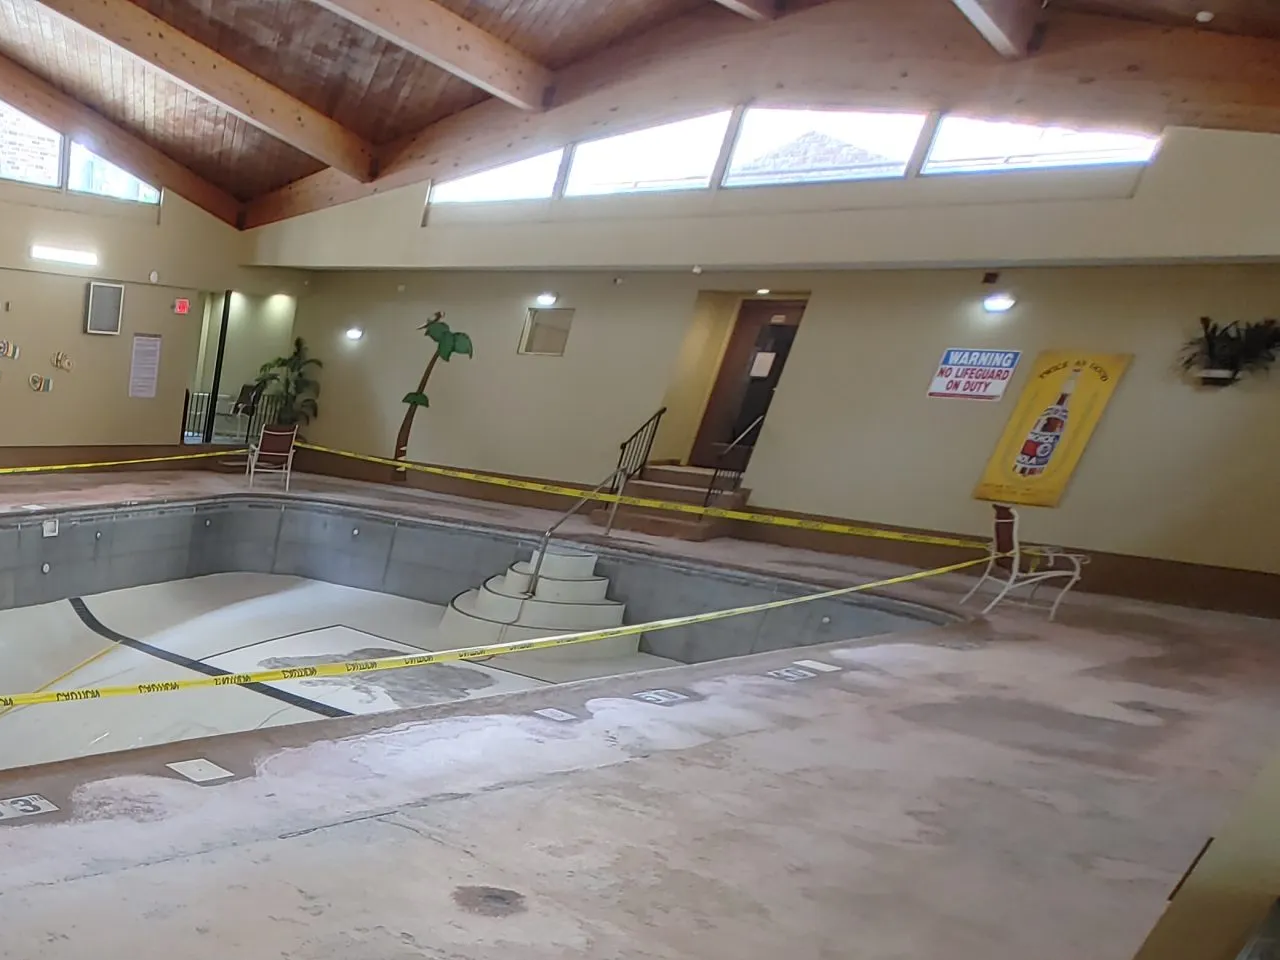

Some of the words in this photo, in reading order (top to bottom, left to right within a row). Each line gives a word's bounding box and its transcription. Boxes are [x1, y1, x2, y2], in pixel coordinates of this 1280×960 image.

[947, 351, 1014, 367] WARNING
[937, 367, 952, 378] NO
[954, 367, 1010, 381] LIFEGUARD
[945, 380, 961, 392] ON
[962, 381, 993, 392] DUTY
[10, 799, 42, 813] 3
